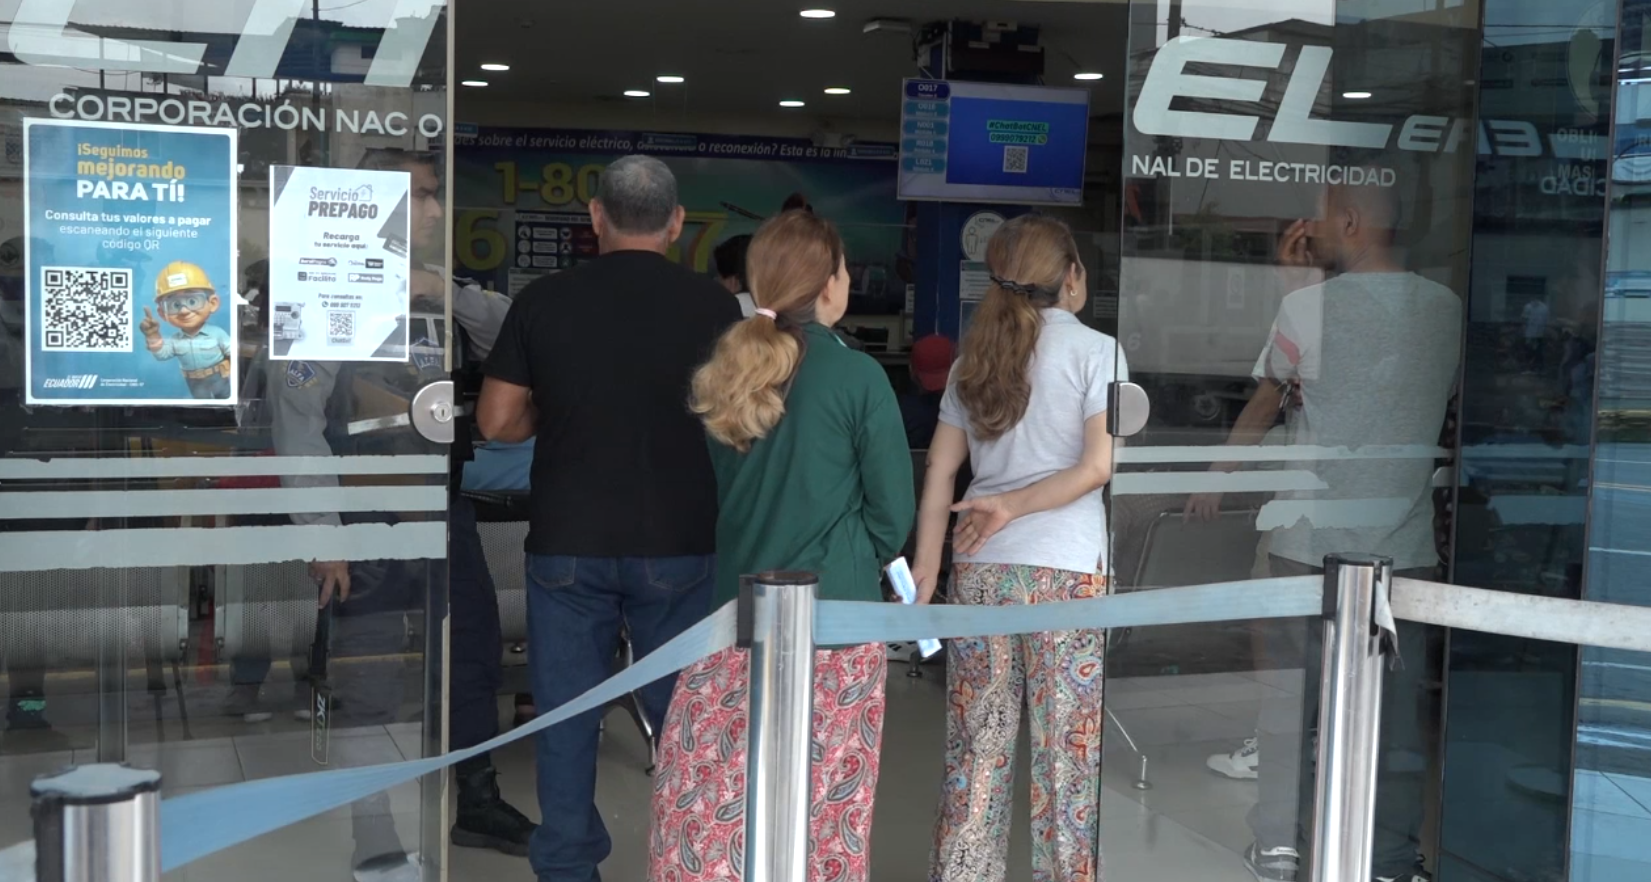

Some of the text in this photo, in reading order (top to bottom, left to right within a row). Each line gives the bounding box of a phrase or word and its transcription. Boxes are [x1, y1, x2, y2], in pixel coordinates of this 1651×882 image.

[1133, 35, 1394, 149] EL
[49, 93, 325, 132] CORPORACIÓN
[479, 133, 513, 147] sobre
[515, 134, 527, 147] el
[530, 135, 575, 149] servicio
[579, 136, 634, 151] eléctrico,
[1557, 127, 1598, 144] OBLI
[709, 142, 777, 156] reconexión?
[780, 144, 803, 157] Esta
[77, 158, 186, 180] mejorando
[1132, 155, 1397, 187] NAL DE ELECTRICIDAD
[77, 178, 185, 202] PARA TÍ!
[309, 186, 359, 202] Servicio
[45, 209, 212, 228] Consulta tus valores a pagar
[308, 201, 378, 219] PREPAGO
[59, 225, 199, 239] escaneando el siguiente
[323, 231, 360, 242] Recarga
[102, 239, 160, 251] código QR
